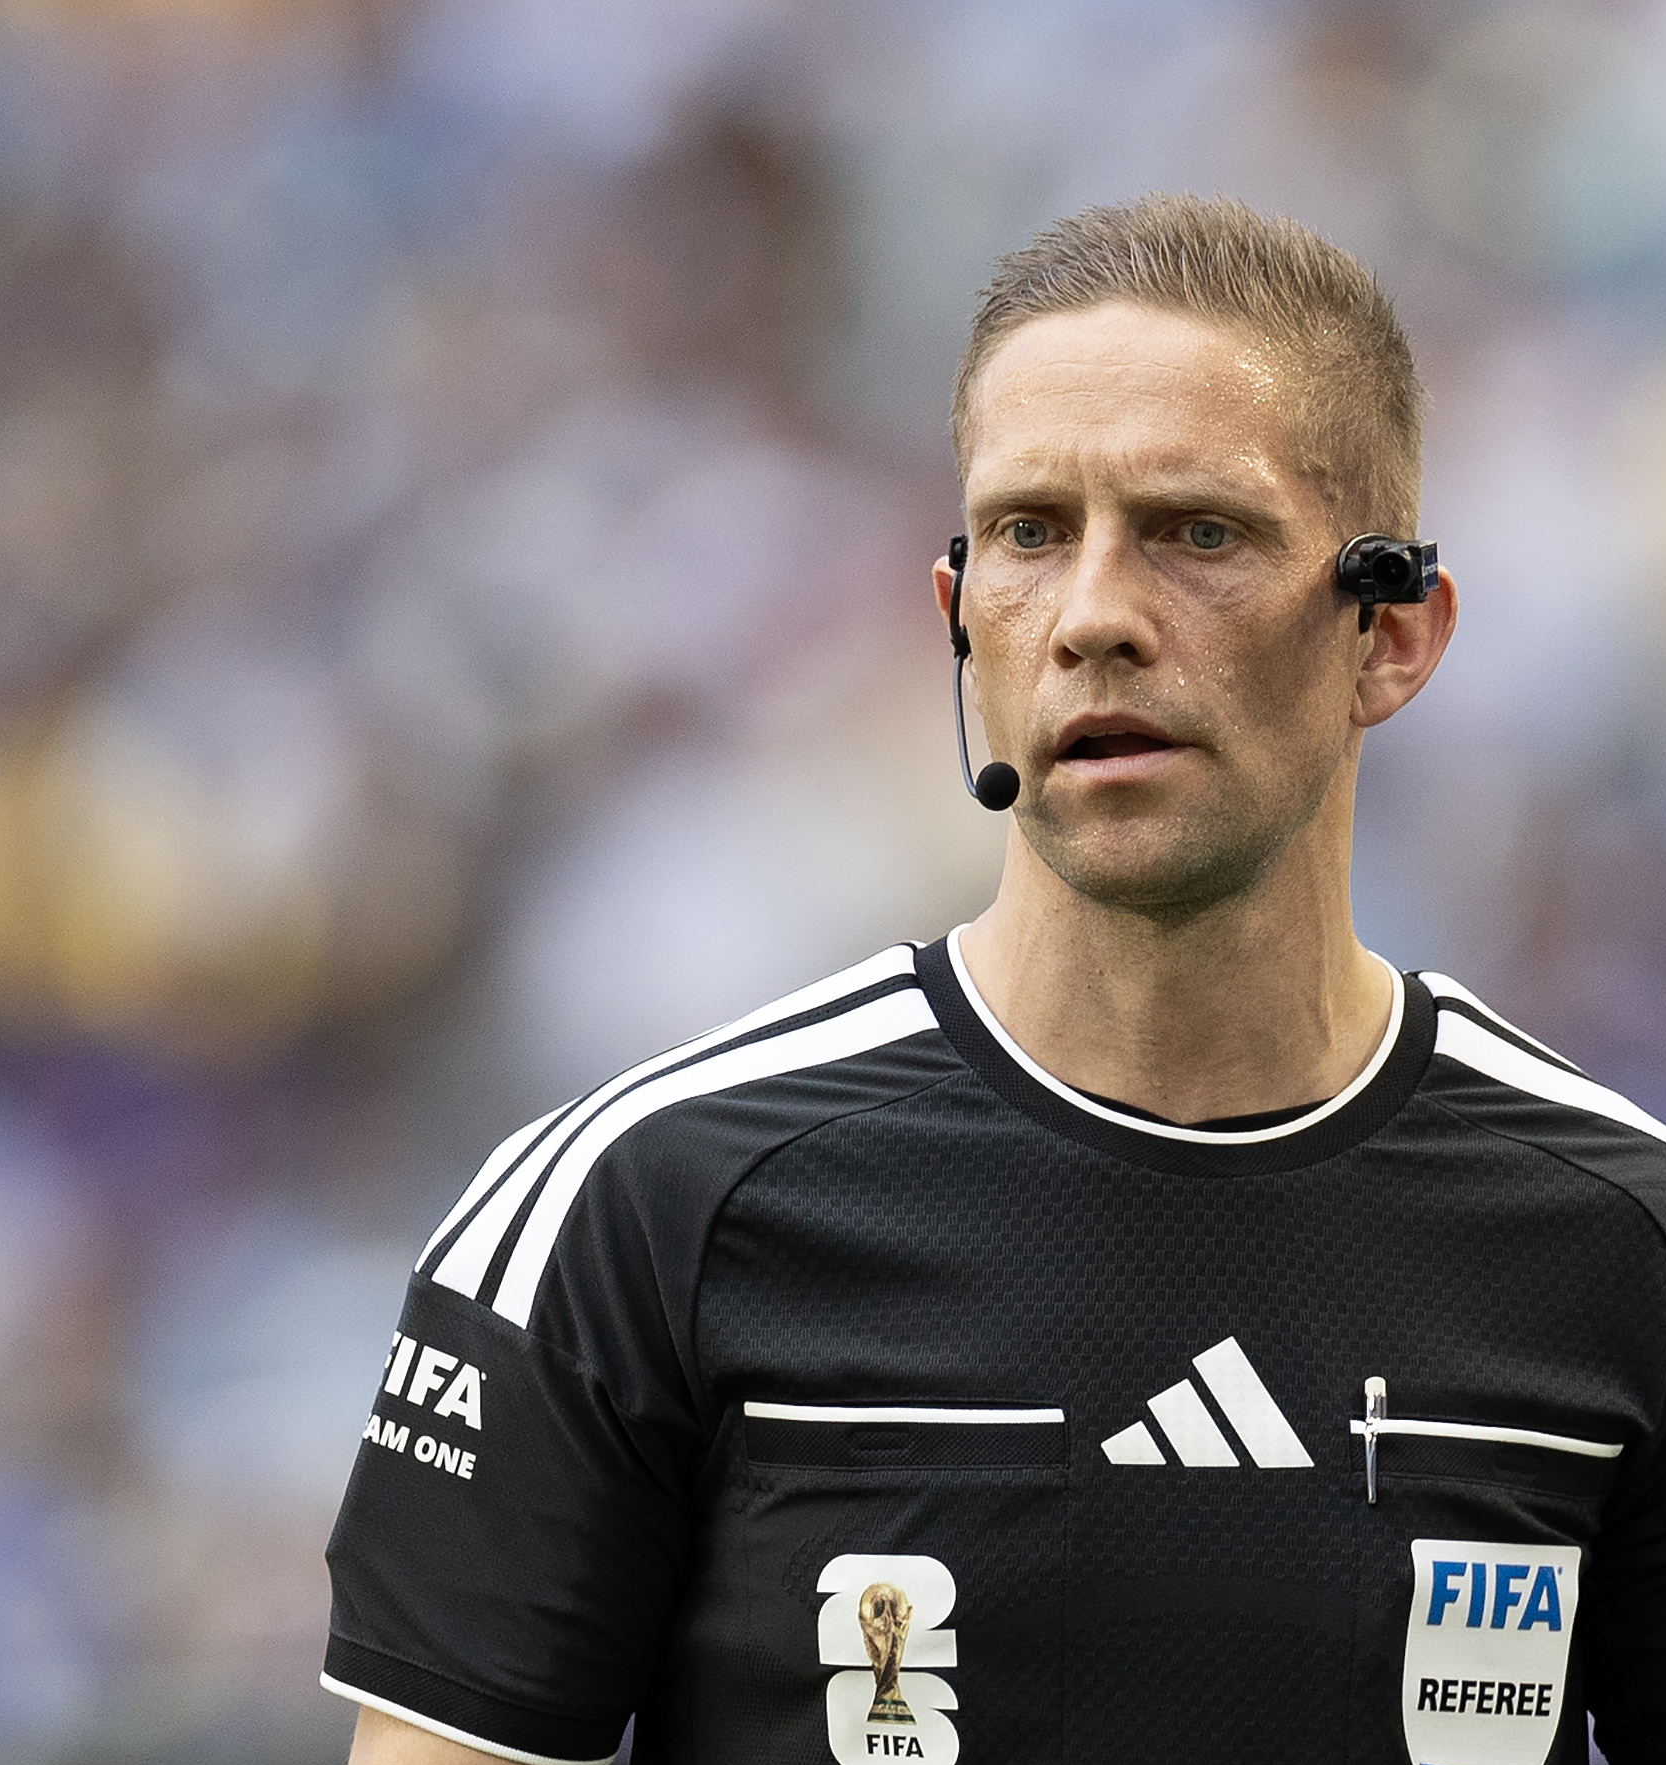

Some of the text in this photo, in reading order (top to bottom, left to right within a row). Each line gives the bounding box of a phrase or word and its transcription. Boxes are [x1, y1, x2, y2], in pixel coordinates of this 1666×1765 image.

[414, 1434, 477, 1480] ONE
[1426, 1560, 1563, 1632] FIFA
[1417, 1678, 1553, 1717] REFEREE
[866, 1733, 925, 1759] FIFA
